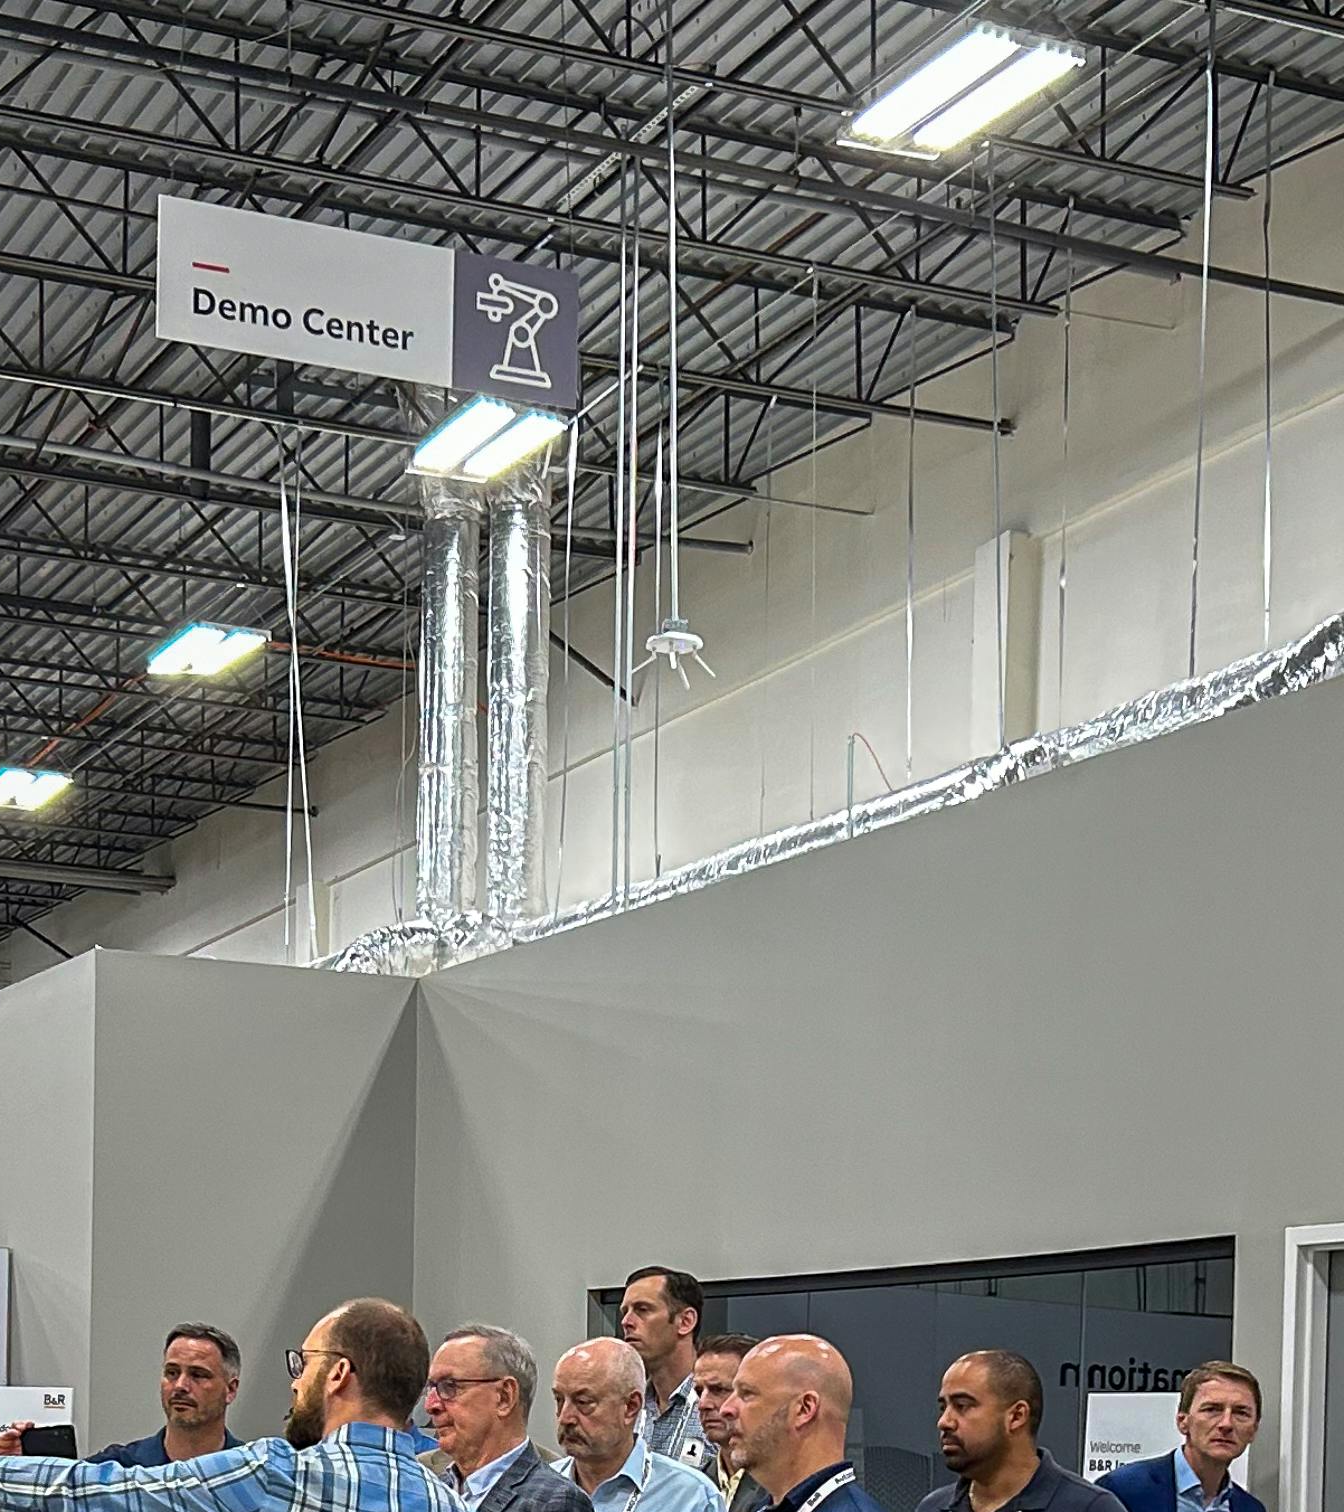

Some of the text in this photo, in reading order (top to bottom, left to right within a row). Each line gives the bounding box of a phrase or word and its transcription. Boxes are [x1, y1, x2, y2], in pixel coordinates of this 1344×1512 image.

[192, 287, 415, 351] Demo Center
[44, 1394, 66, 1406] B&R
[1090, 1440, 1141, 1453] Welcome
[1089, 1459, 1113, 1471] B&R
